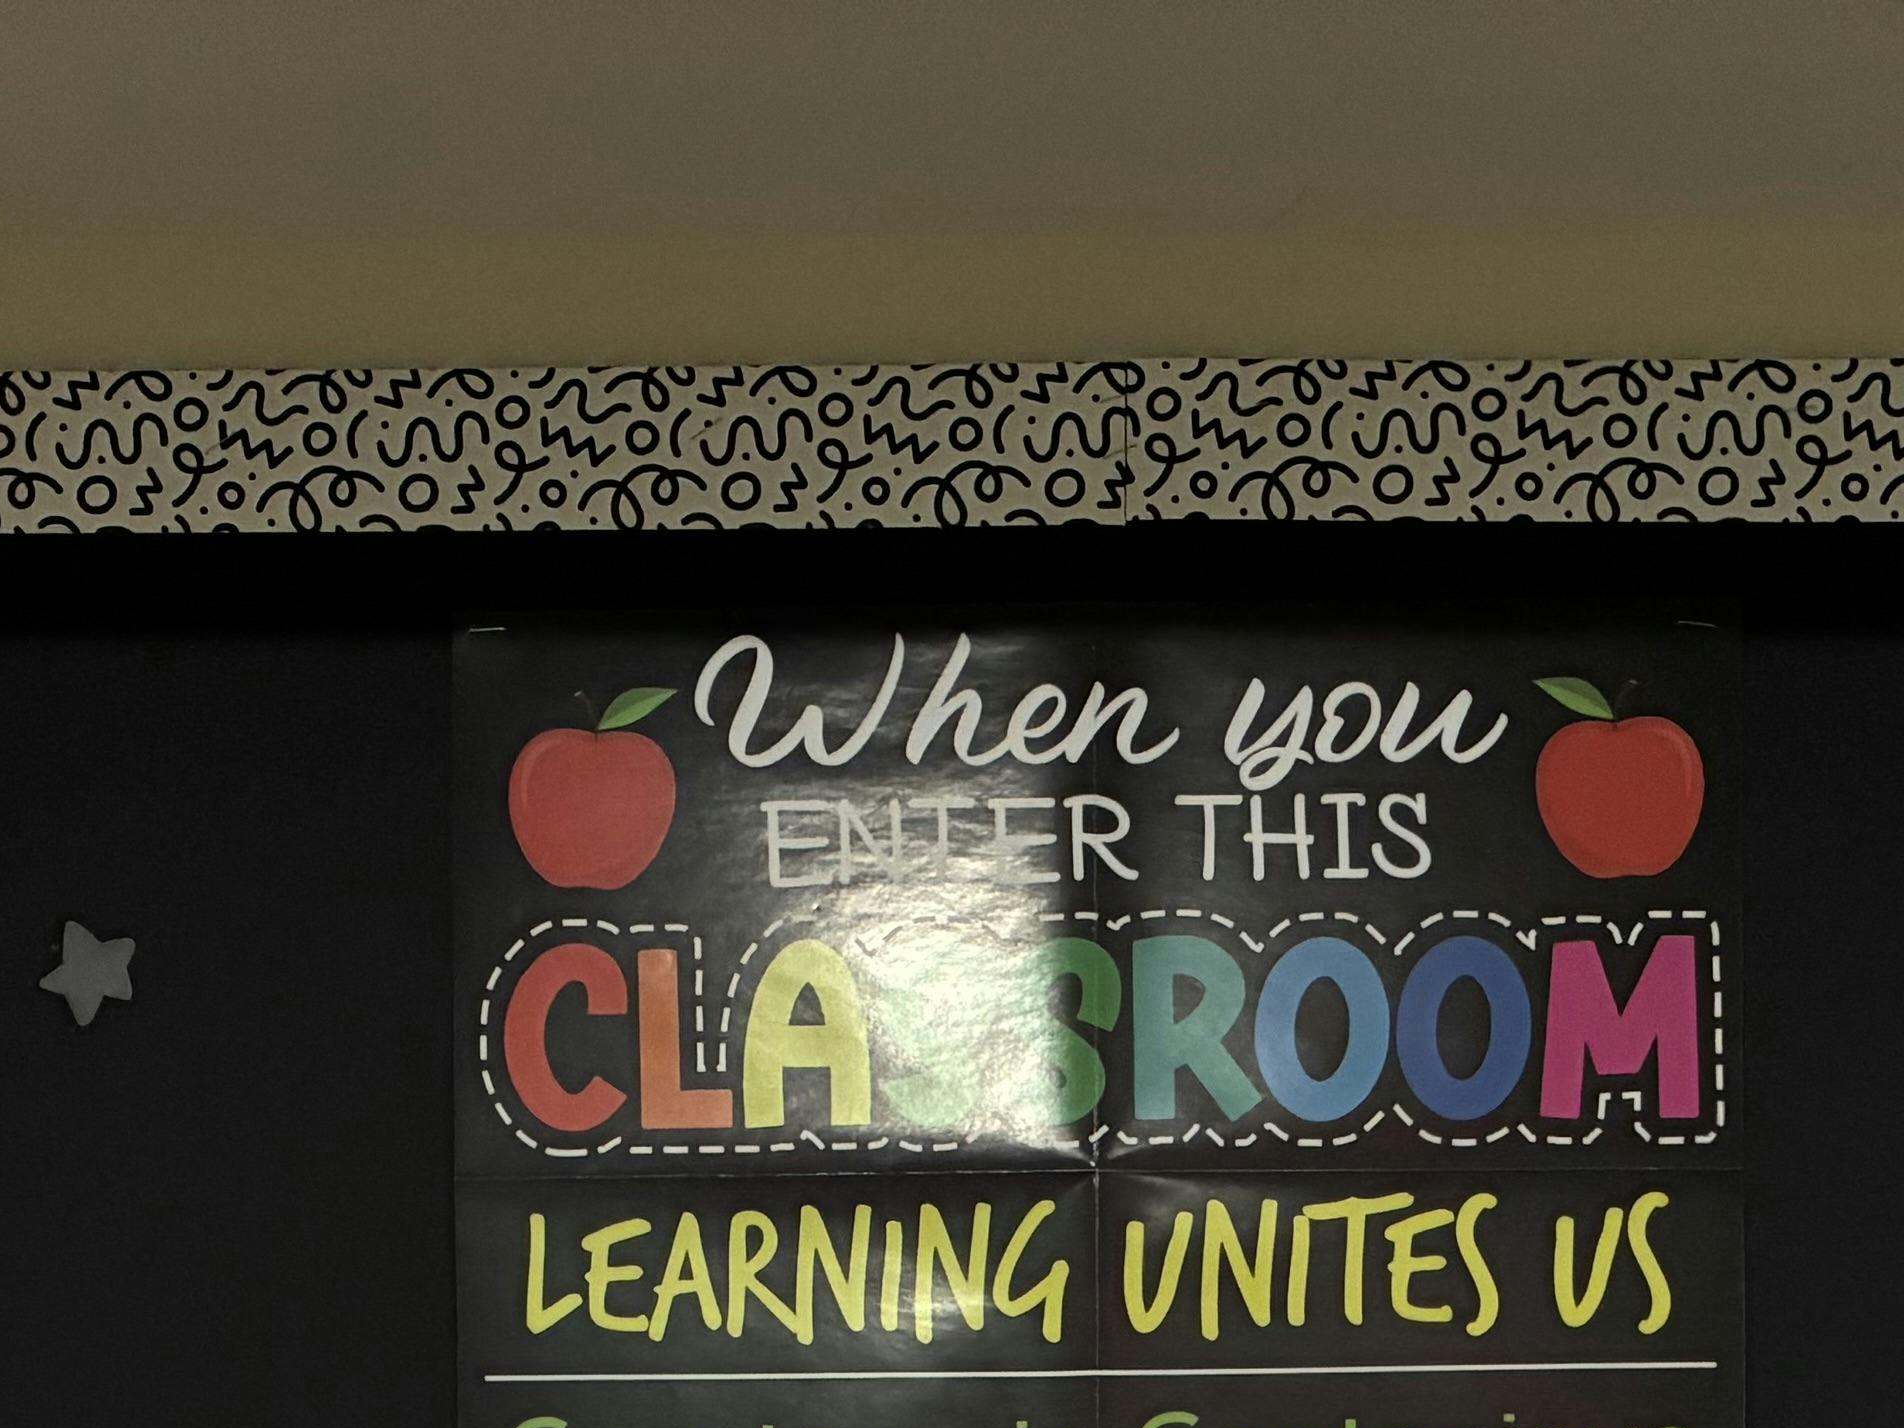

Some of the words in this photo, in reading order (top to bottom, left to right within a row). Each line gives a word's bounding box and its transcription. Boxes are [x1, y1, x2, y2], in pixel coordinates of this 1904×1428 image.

[693, 635, 1182, 772] When
[1222, 675, 1509, 792] you
[760, 797, 1140, 890] ENTER
[1175, 790, 1434, 886] THIS
[524, 1201, 1070, 1345] LEARNING
[1124, 1192, 1497, 1343] UNITES
[1553, 1191, 1673, 1337] US
